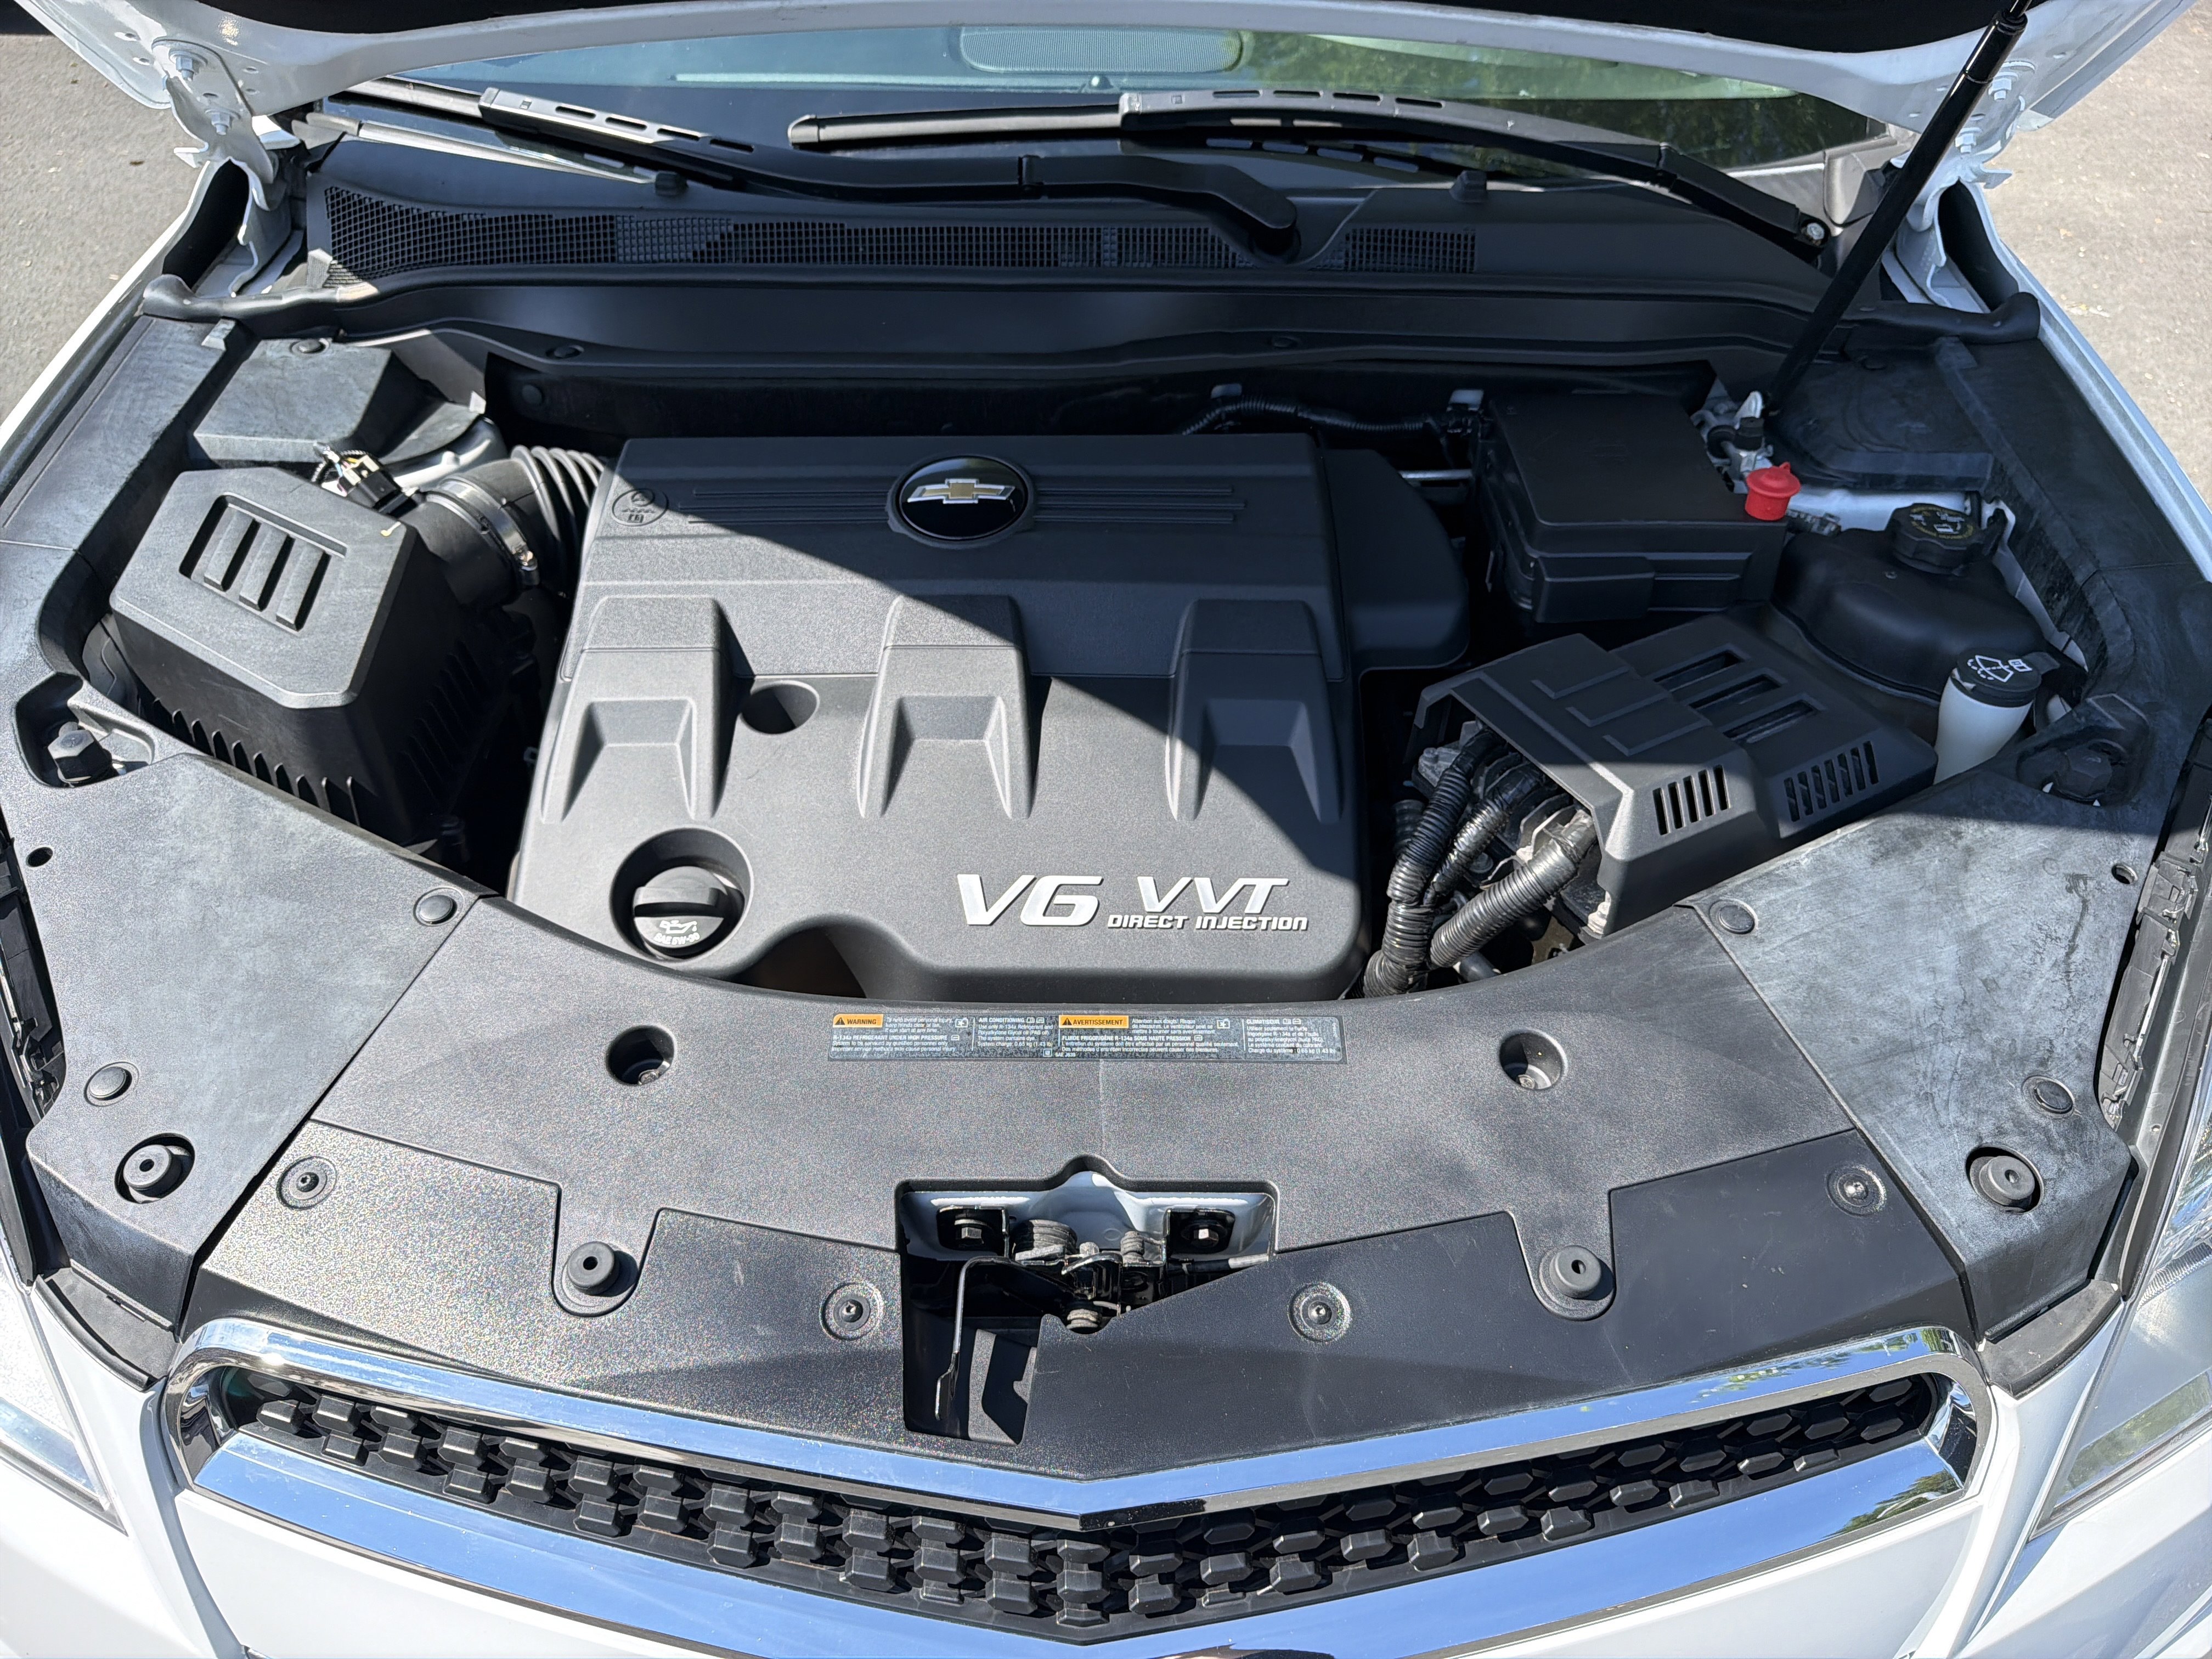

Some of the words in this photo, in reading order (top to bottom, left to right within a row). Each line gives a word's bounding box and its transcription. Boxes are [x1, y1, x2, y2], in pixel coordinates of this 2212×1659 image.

[957, 874, 1103, 927] V6
[1137, 877, 1289, 915] VVT
[1108, 915, 1189, 930] DIRECT
[1195, 916, 1309, 931] INJECTION
[653, 933, 672, 945] SAE
[672, 932, 700, 945] 5W-30
